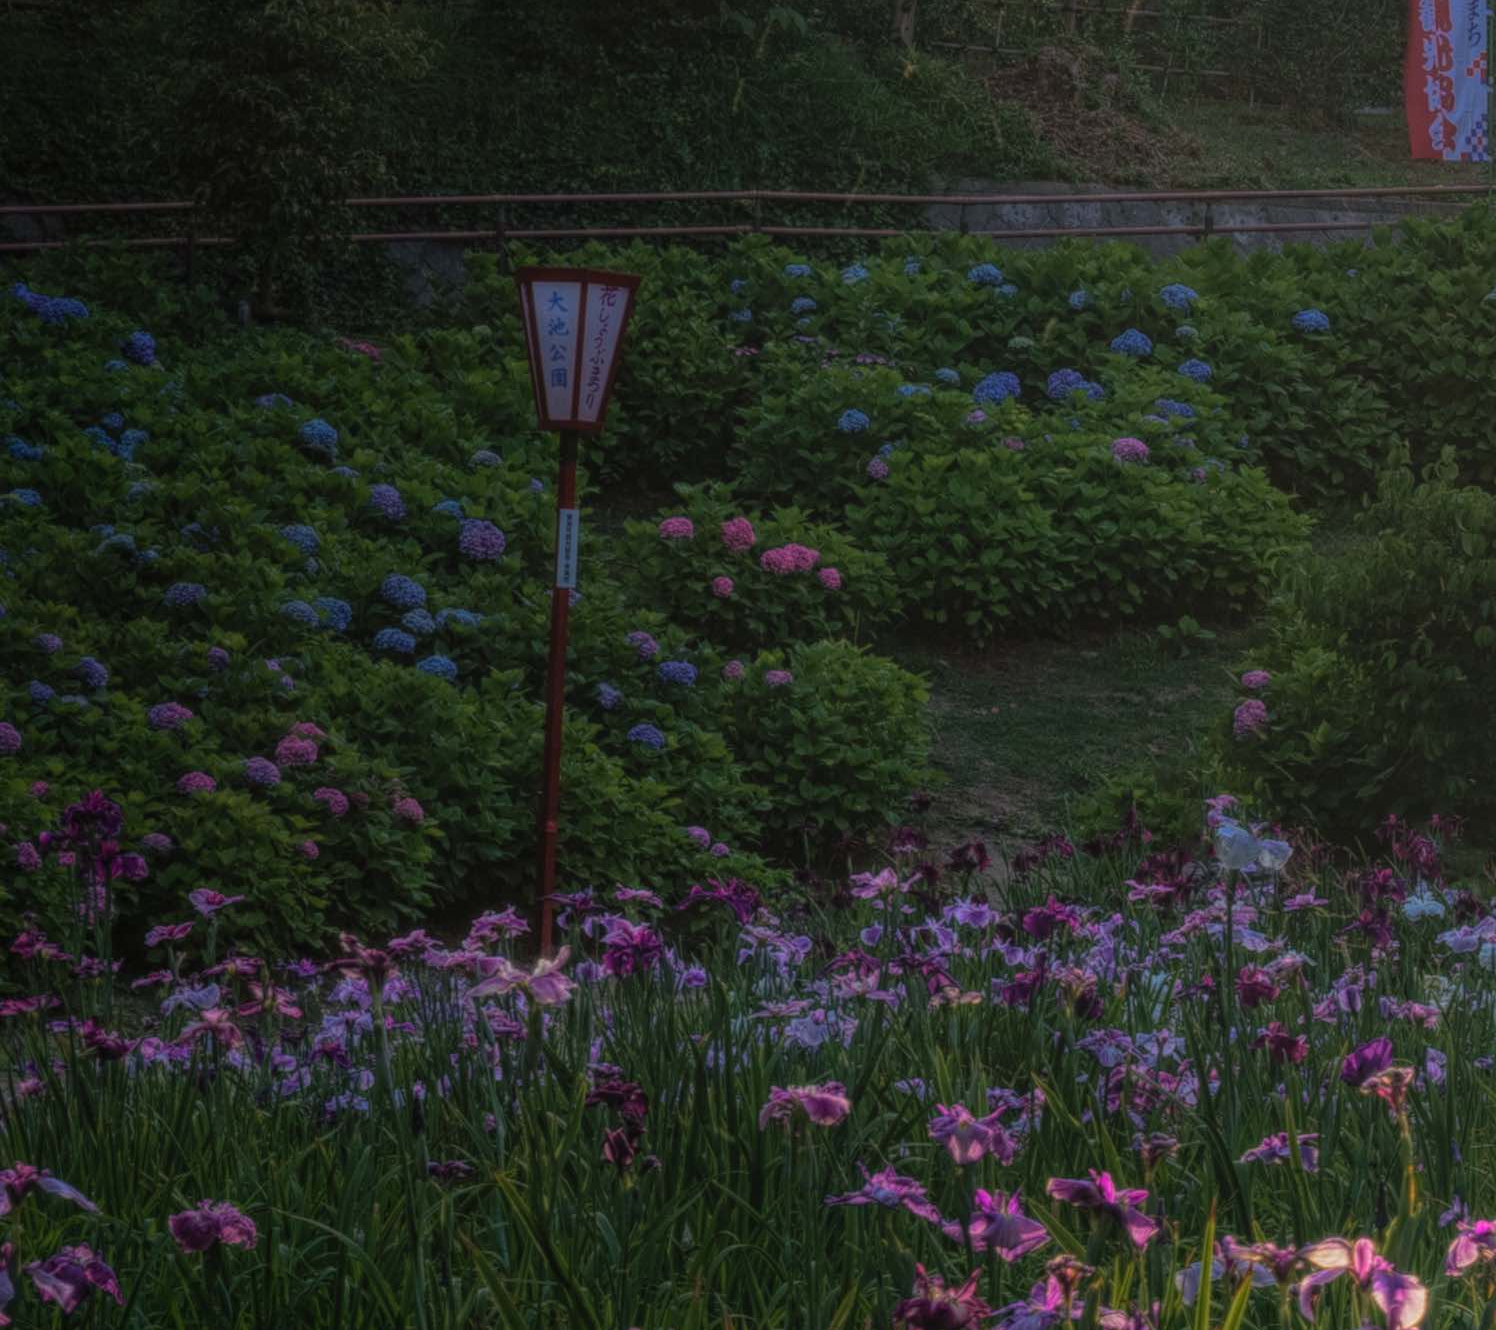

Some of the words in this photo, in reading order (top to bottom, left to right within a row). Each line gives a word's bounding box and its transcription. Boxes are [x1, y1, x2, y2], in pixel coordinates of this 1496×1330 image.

[548, 290, 570, 388] 大池公園
[584, 286, 624, 409] 花しょうぶまつり
